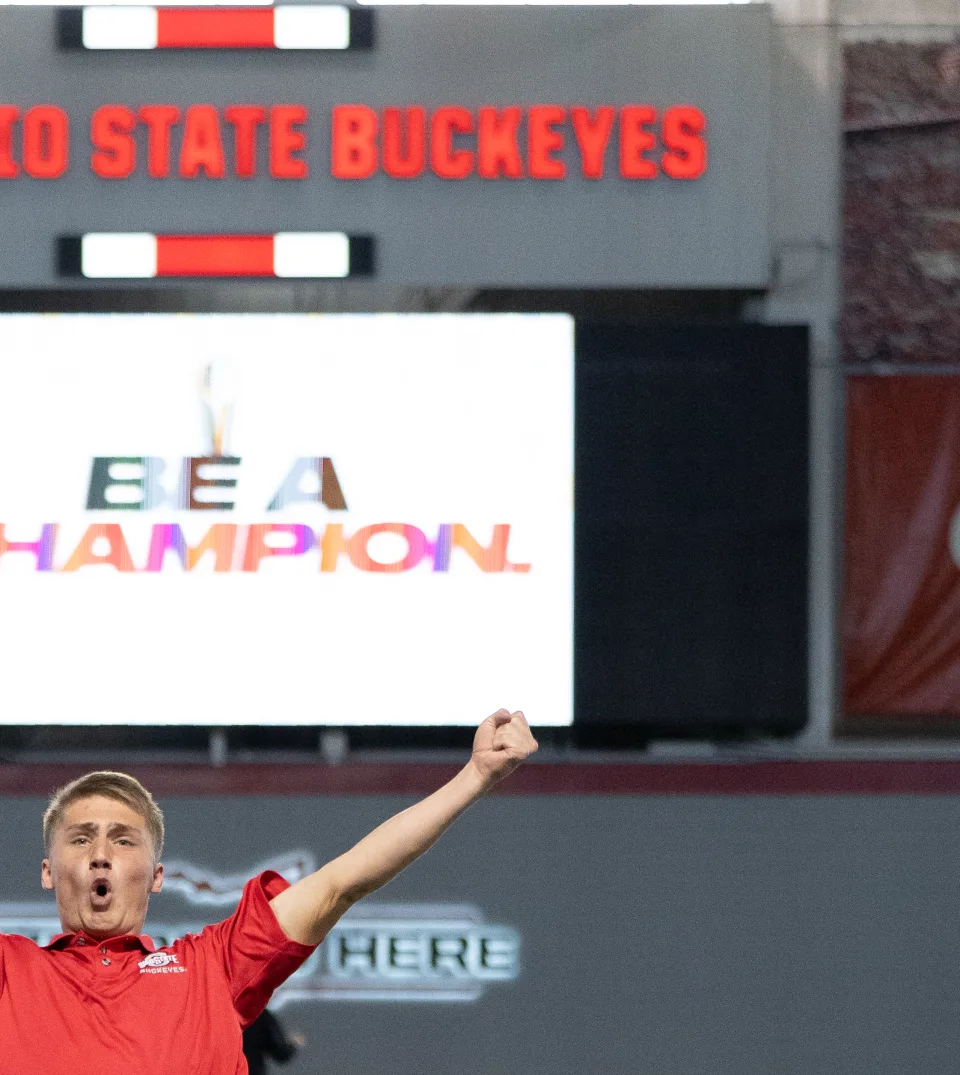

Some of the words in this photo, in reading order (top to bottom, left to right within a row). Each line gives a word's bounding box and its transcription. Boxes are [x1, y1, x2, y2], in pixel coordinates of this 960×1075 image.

[90, 105, 308, 178] STATE
[331, 104, 707, 179] BUCKEYES
[85, 456, 242, 512] BE
[266, 456, 349, 512] A
[337, 932, 520, 974] HERE
